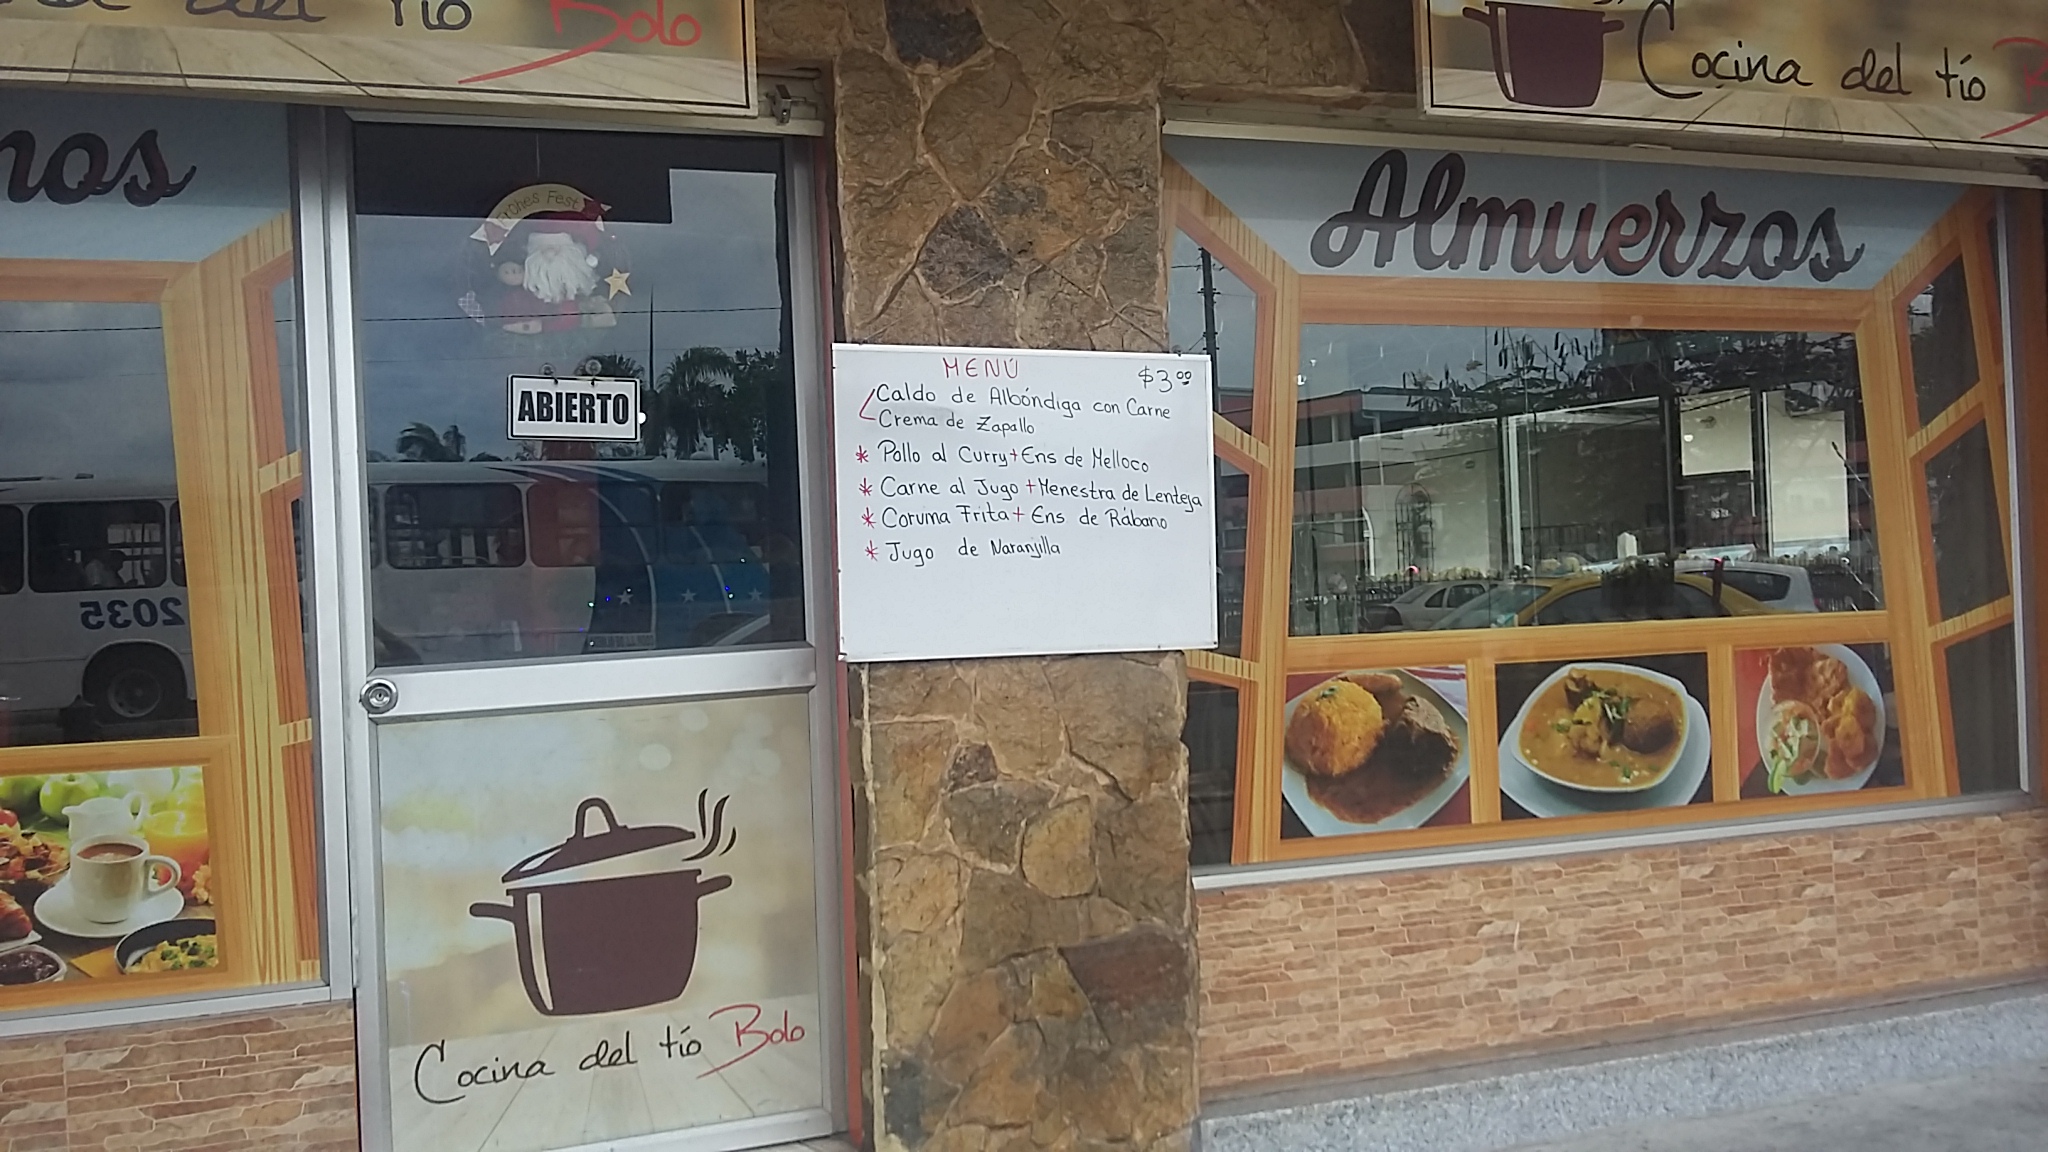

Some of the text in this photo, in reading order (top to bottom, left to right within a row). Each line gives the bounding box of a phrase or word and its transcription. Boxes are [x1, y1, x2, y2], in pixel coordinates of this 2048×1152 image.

[1638, 0, 1814, 99] Cocina
[1841, 42, 1913, 95] del
[1935, 47, 1986, 101] tío
[547, 190, 580, 210] Fest
[1310, 149, 1866, 283] Almuerzos
[942, 357, 1018, 379] MENÚ
[518, 390, 629, 425] ABIERTO
[876, 382, 1171, 419] Caldo de Albóndiga con Carne
[879, 408, 1035, 438] Crema de Zapallo
[877, 439, 921, 463] Pollo
[931, 442, 947, 462] al
[1064, 447, 1083, 468] de
[1092, 447, 1149, 473] Melloco
[880, 476, 940, 497] Carne
[949, 476, 966, 495] al
[973, 479, 1019, 501] Jugo
[1122, 483, 1139, 502] de
[1145, 484, 1203, 512] Lenteja
[1031, 505, 1065, 524] Ens
[1079, 507, 1099, 526] de
[1105, 506, 1168, 530] Rábano
[885, 534, 1061, 567] Jugo de Naranjilla
[414, 1004, 806, 1104] Cocina del tío Bolo
